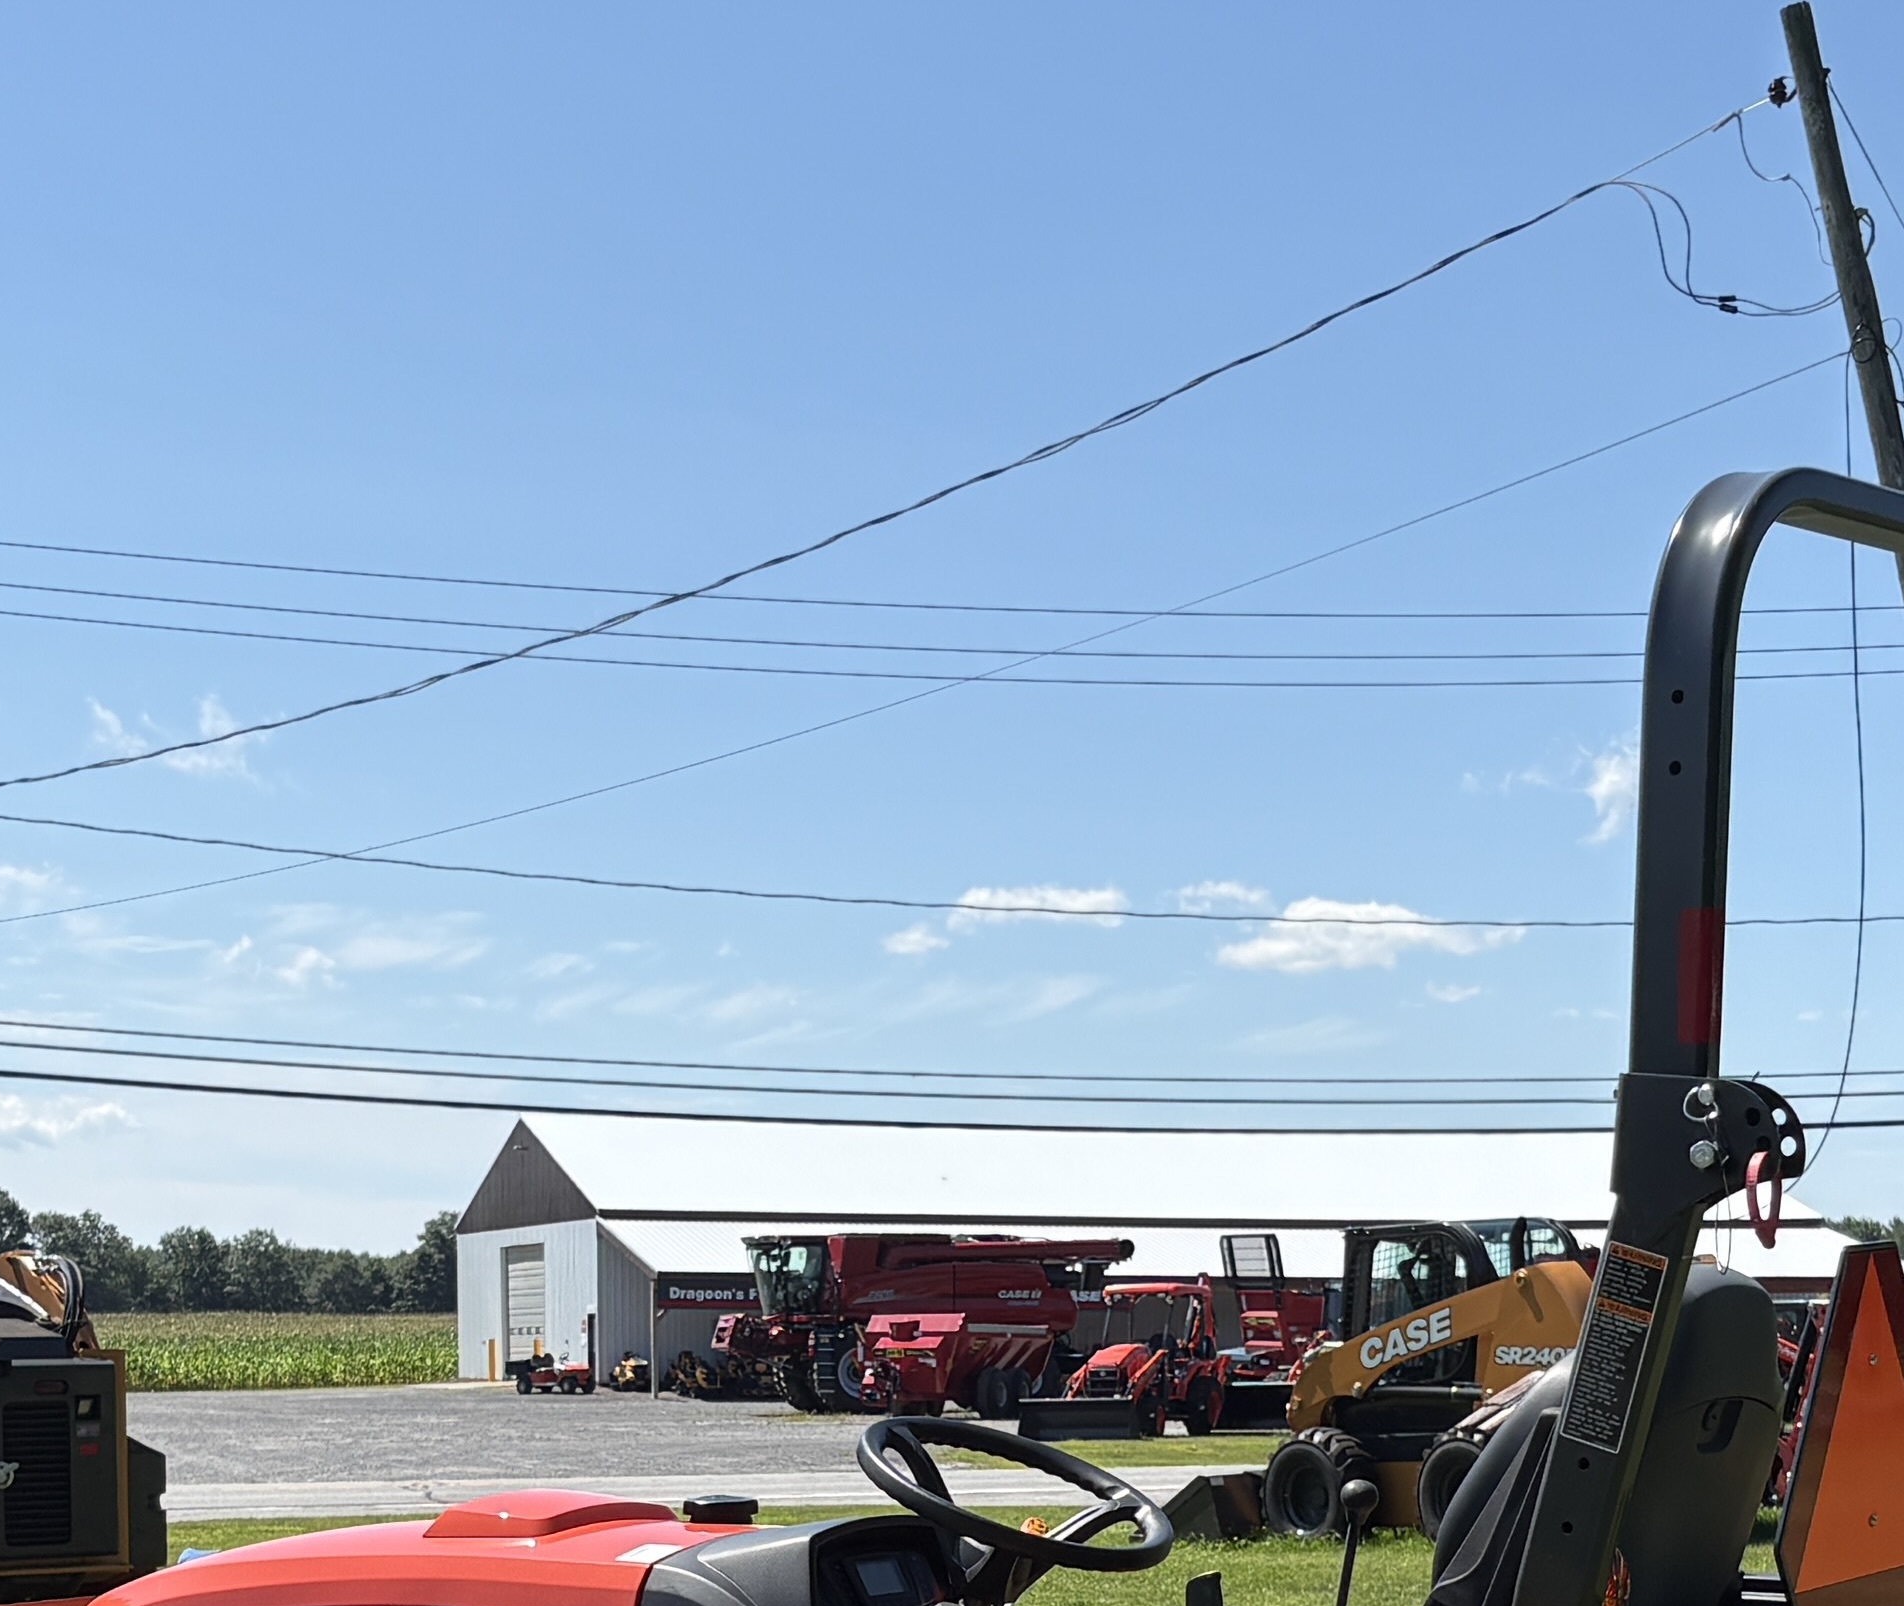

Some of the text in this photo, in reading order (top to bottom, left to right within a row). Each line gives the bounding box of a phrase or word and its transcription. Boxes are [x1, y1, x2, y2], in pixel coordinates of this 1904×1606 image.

[669, 1286, 745, 1302] Dragoon's
[997, 1289, 1030, 1299] CASE
[1359, 1307, 1452, 1370] CASE
